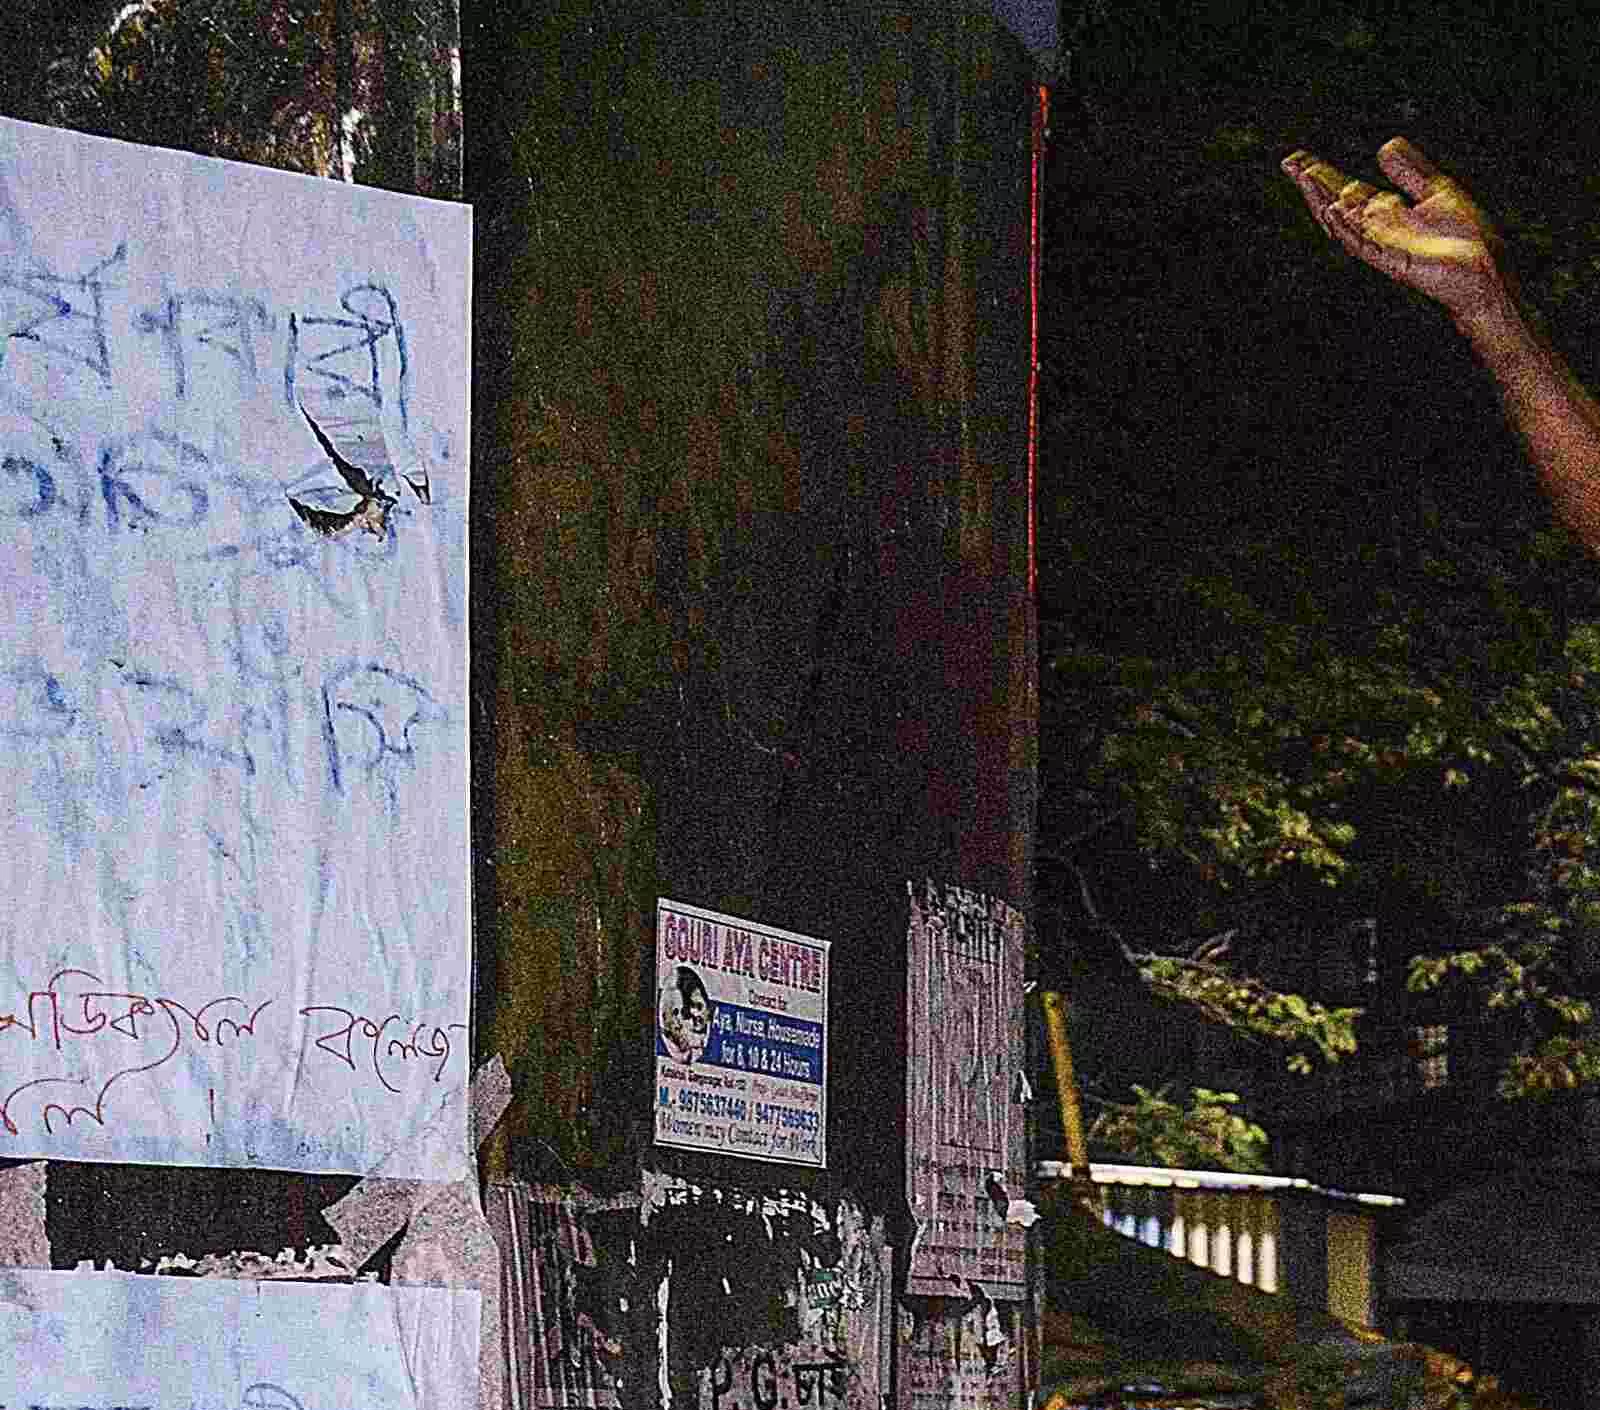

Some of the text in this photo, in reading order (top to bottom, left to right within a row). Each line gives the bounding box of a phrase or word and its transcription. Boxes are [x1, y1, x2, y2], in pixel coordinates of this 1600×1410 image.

[665, 911, 821, 995] GOURI AYA CENTRE
